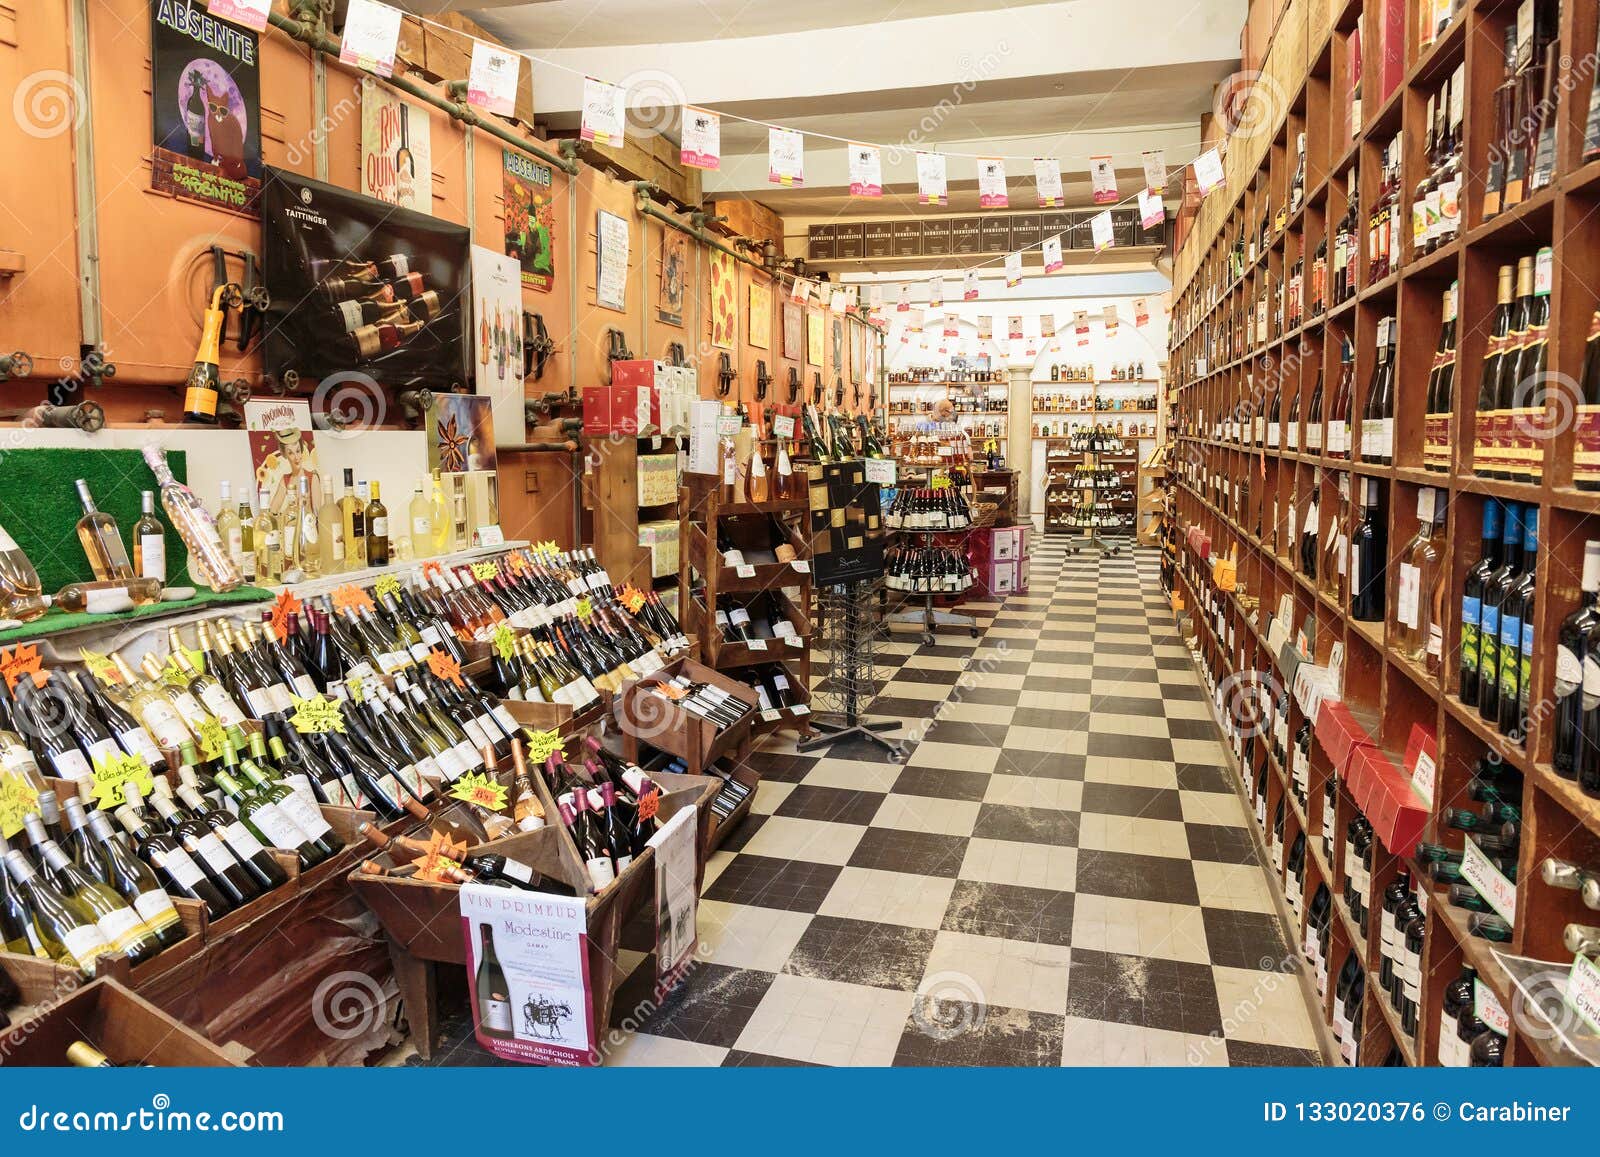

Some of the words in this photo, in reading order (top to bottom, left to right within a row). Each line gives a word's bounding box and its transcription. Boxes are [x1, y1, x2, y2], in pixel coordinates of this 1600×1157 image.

[157, 0, 254, 66] ABSENTE
[506, 151, 550, 187] ABSENTE
[285, 208, 327, 226] TAITTINGER
[467, 894, 493, 909] VIN
[502, 899, 577, 919] PRIMEUR
[504, 921, 572, 941] Modestine
[526, 942, 549, 950] GAMAY
[492, 1039, 533, 1051] VIGNERONS
